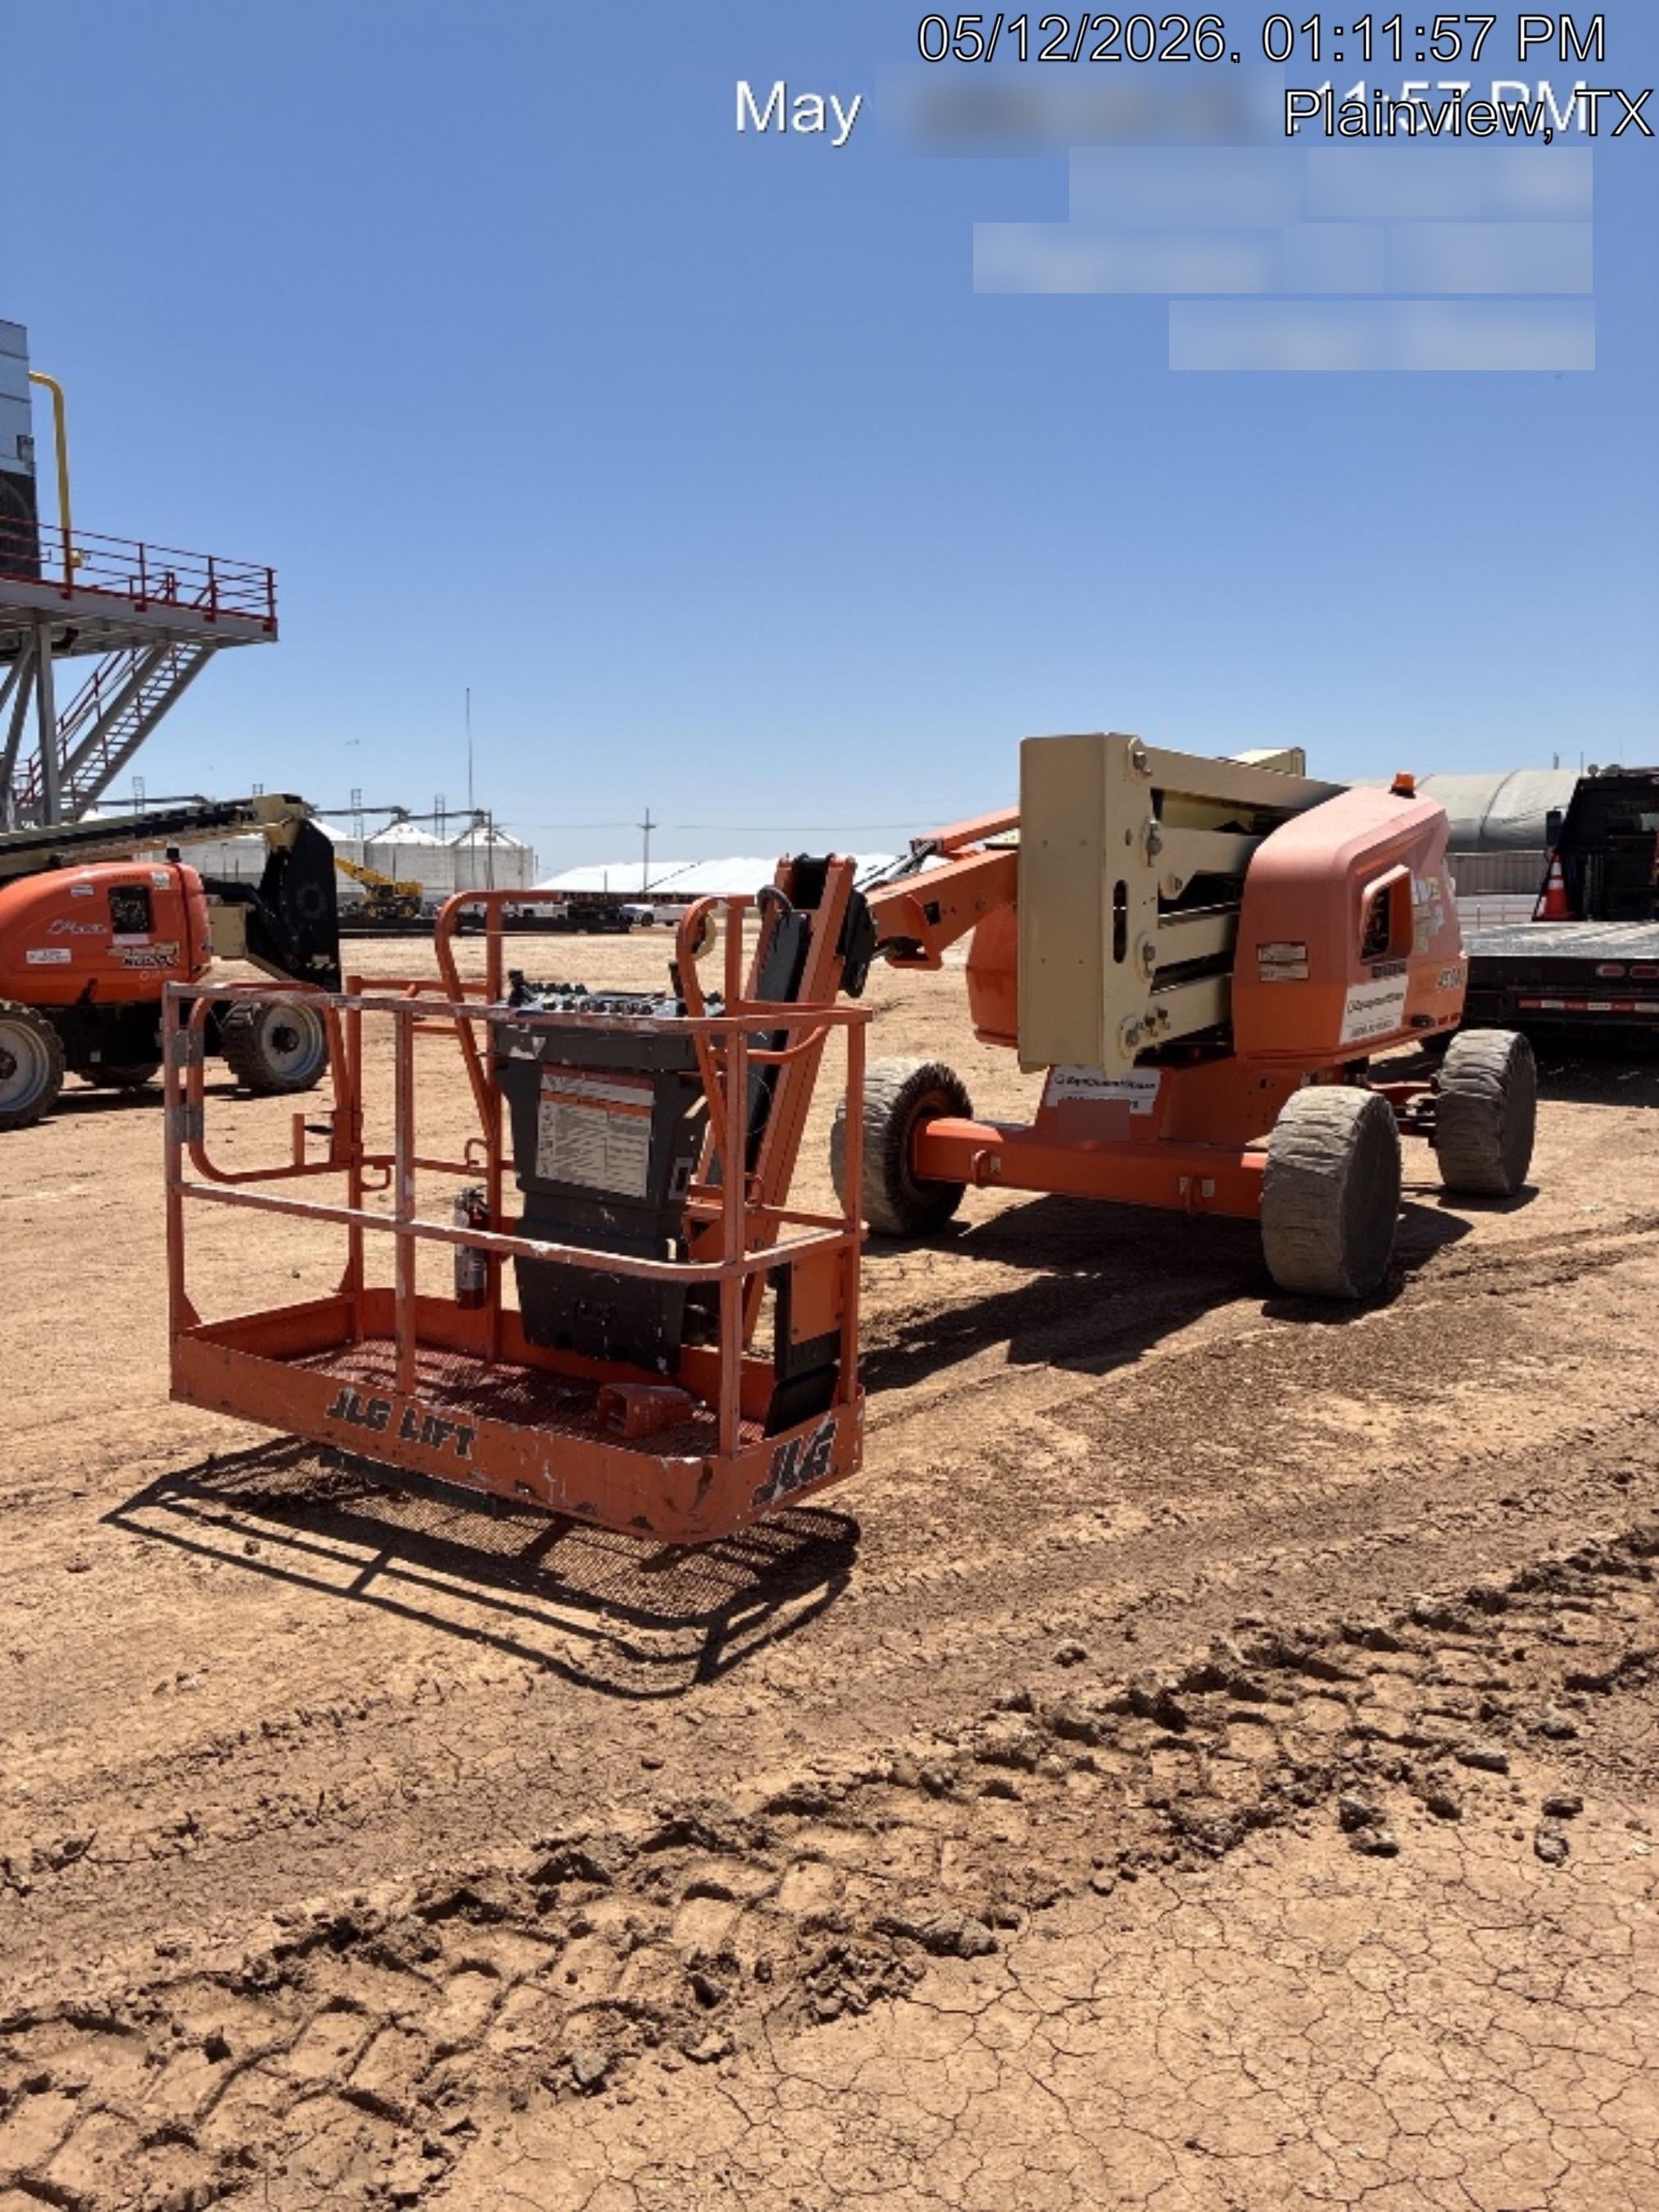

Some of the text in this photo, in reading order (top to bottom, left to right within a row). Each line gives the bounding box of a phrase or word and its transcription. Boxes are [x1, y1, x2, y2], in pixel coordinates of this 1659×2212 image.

[325, 1387, 477, 1460] JLG LIFT
[749, 1412, 838, 1509] JLG
